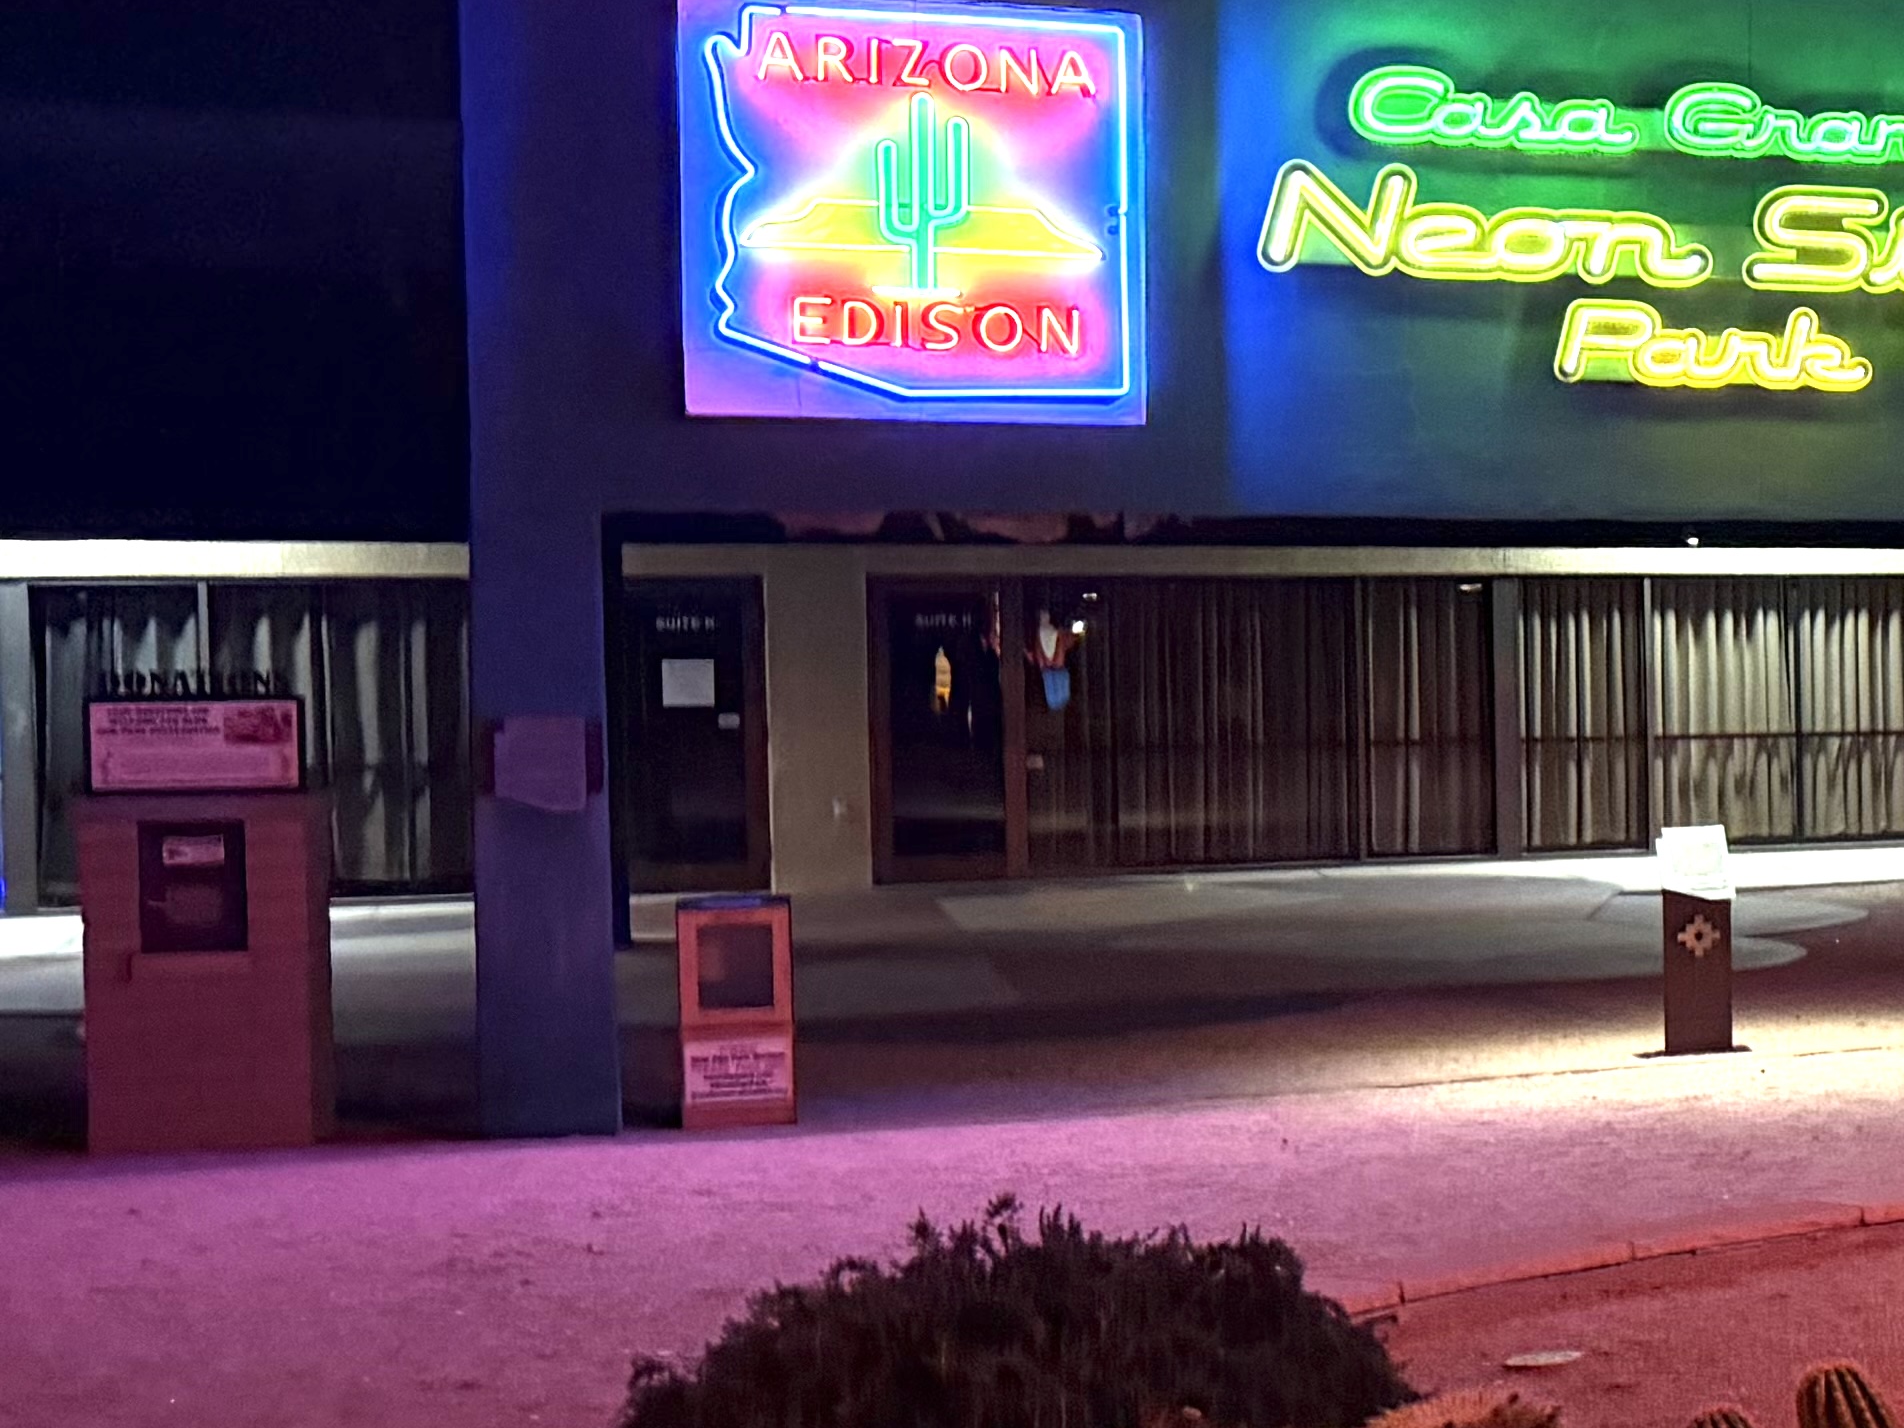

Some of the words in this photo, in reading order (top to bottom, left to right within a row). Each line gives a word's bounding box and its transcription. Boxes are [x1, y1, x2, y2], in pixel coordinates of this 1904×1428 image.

[755, 31, 1098, 97] ARIZONA
[1346, 63, 1640, 156] Casa
[1258, 158, 1714, 289] Neon
[791, 295, 1081, 355] EDISON
[1553, 296, 1874, 393] Park
